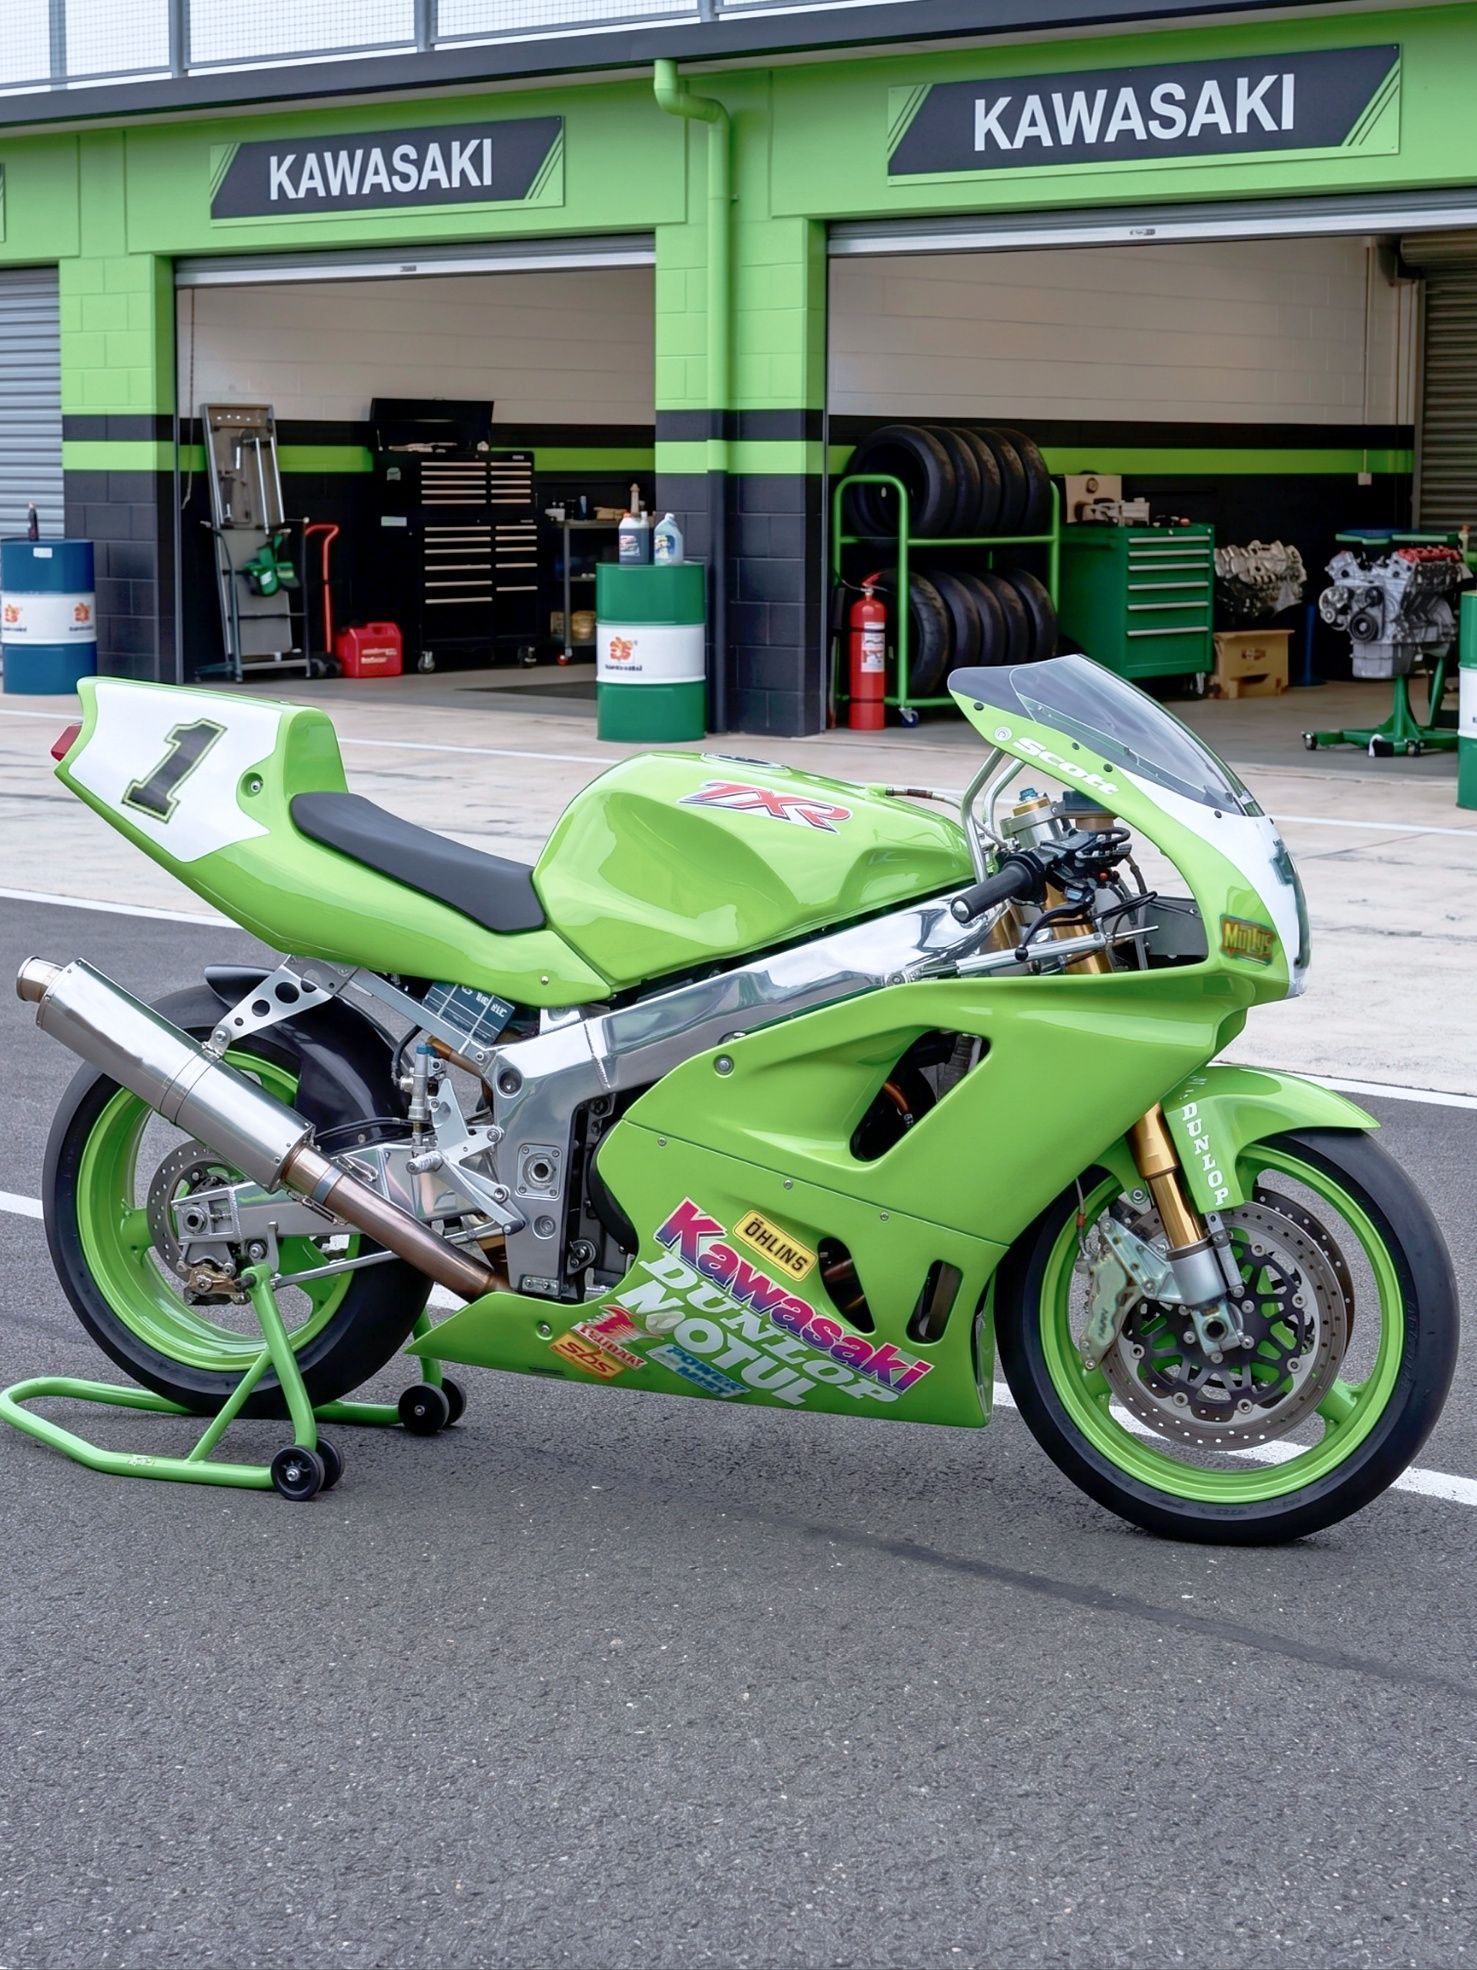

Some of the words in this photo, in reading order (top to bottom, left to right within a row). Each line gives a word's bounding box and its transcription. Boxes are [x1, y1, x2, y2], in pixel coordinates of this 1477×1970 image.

[973, 73, 1296, 152] KAWASAKI
[269, 137, 493, 201] KAWASAKI
[120, 717, 228, 824] 1
[1182, 1102, 1229, 1206] DUNLOP
[653, 1197, 935, 1394] Kawasaki
[743, 1217, 810, 1273] ÖHLINS
[638, 1252, 904, 1403] DUNLOP
